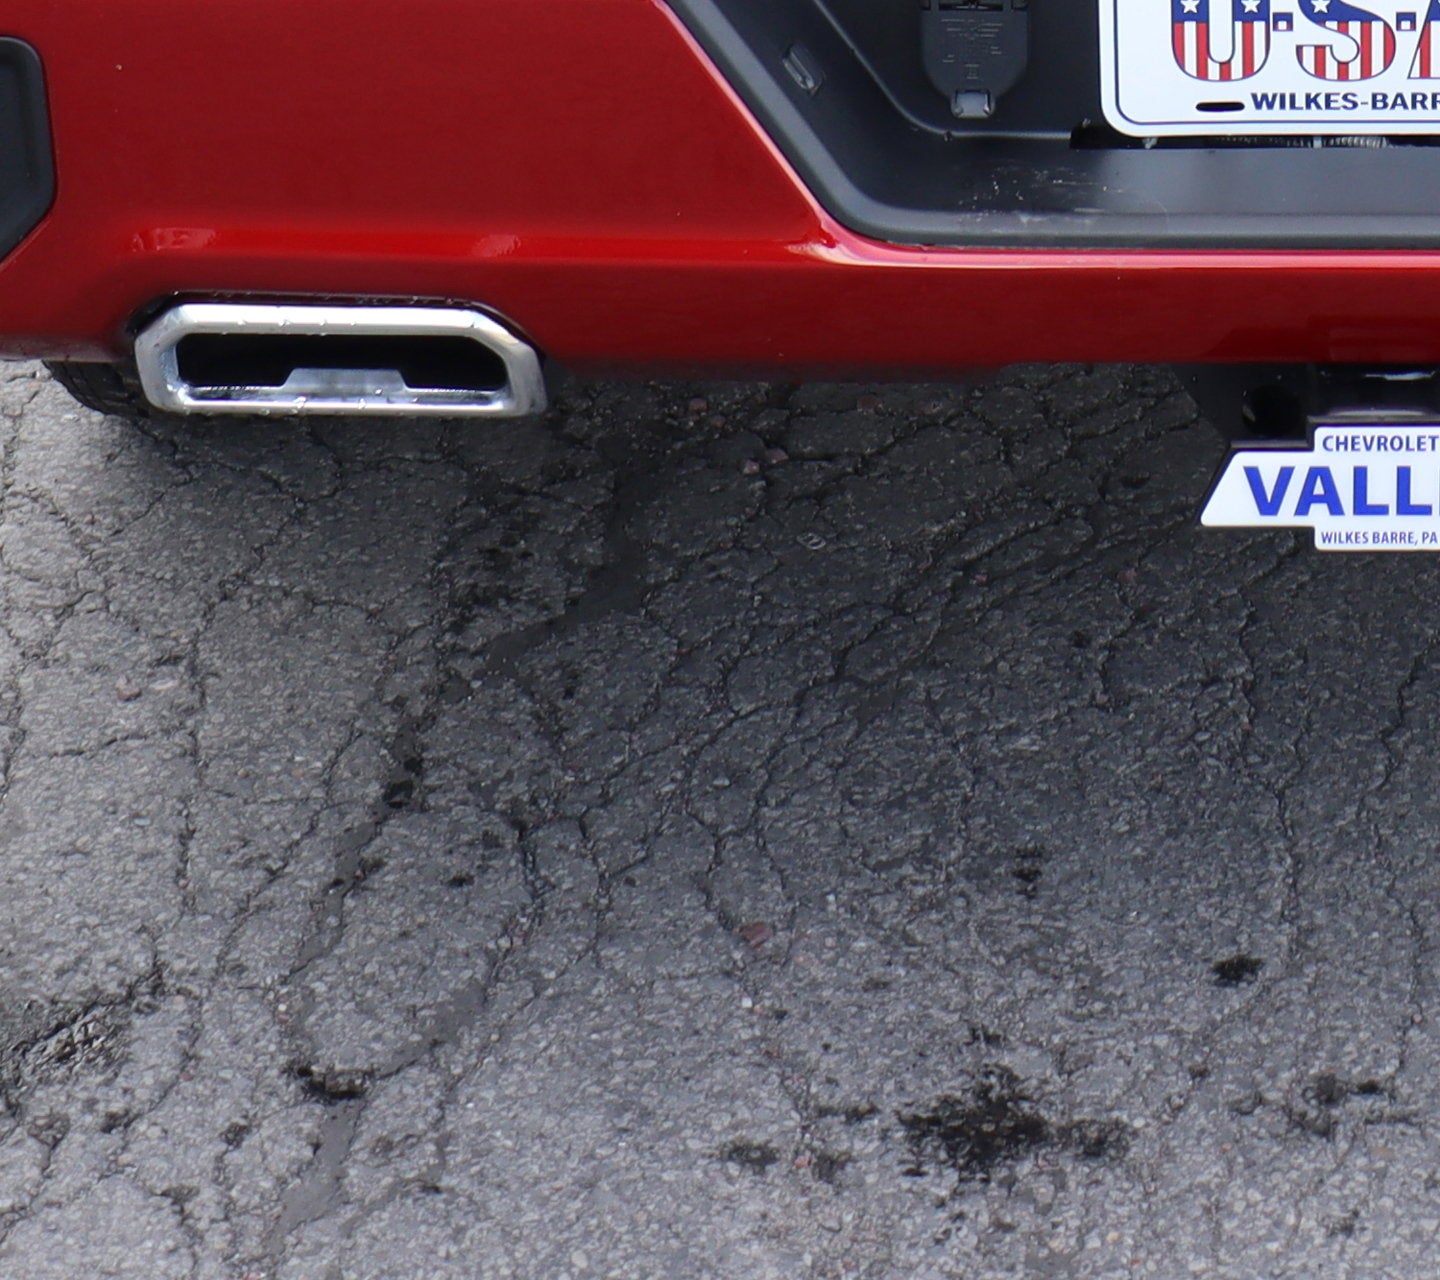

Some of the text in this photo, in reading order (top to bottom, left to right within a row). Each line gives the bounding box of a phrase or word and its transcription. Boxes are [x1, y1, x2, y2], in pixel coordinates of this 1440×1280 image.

[1322, 435, 1439, 452] CHEVROLET
[1321, 531, 1438, 547] WILKES BARRE, PA
